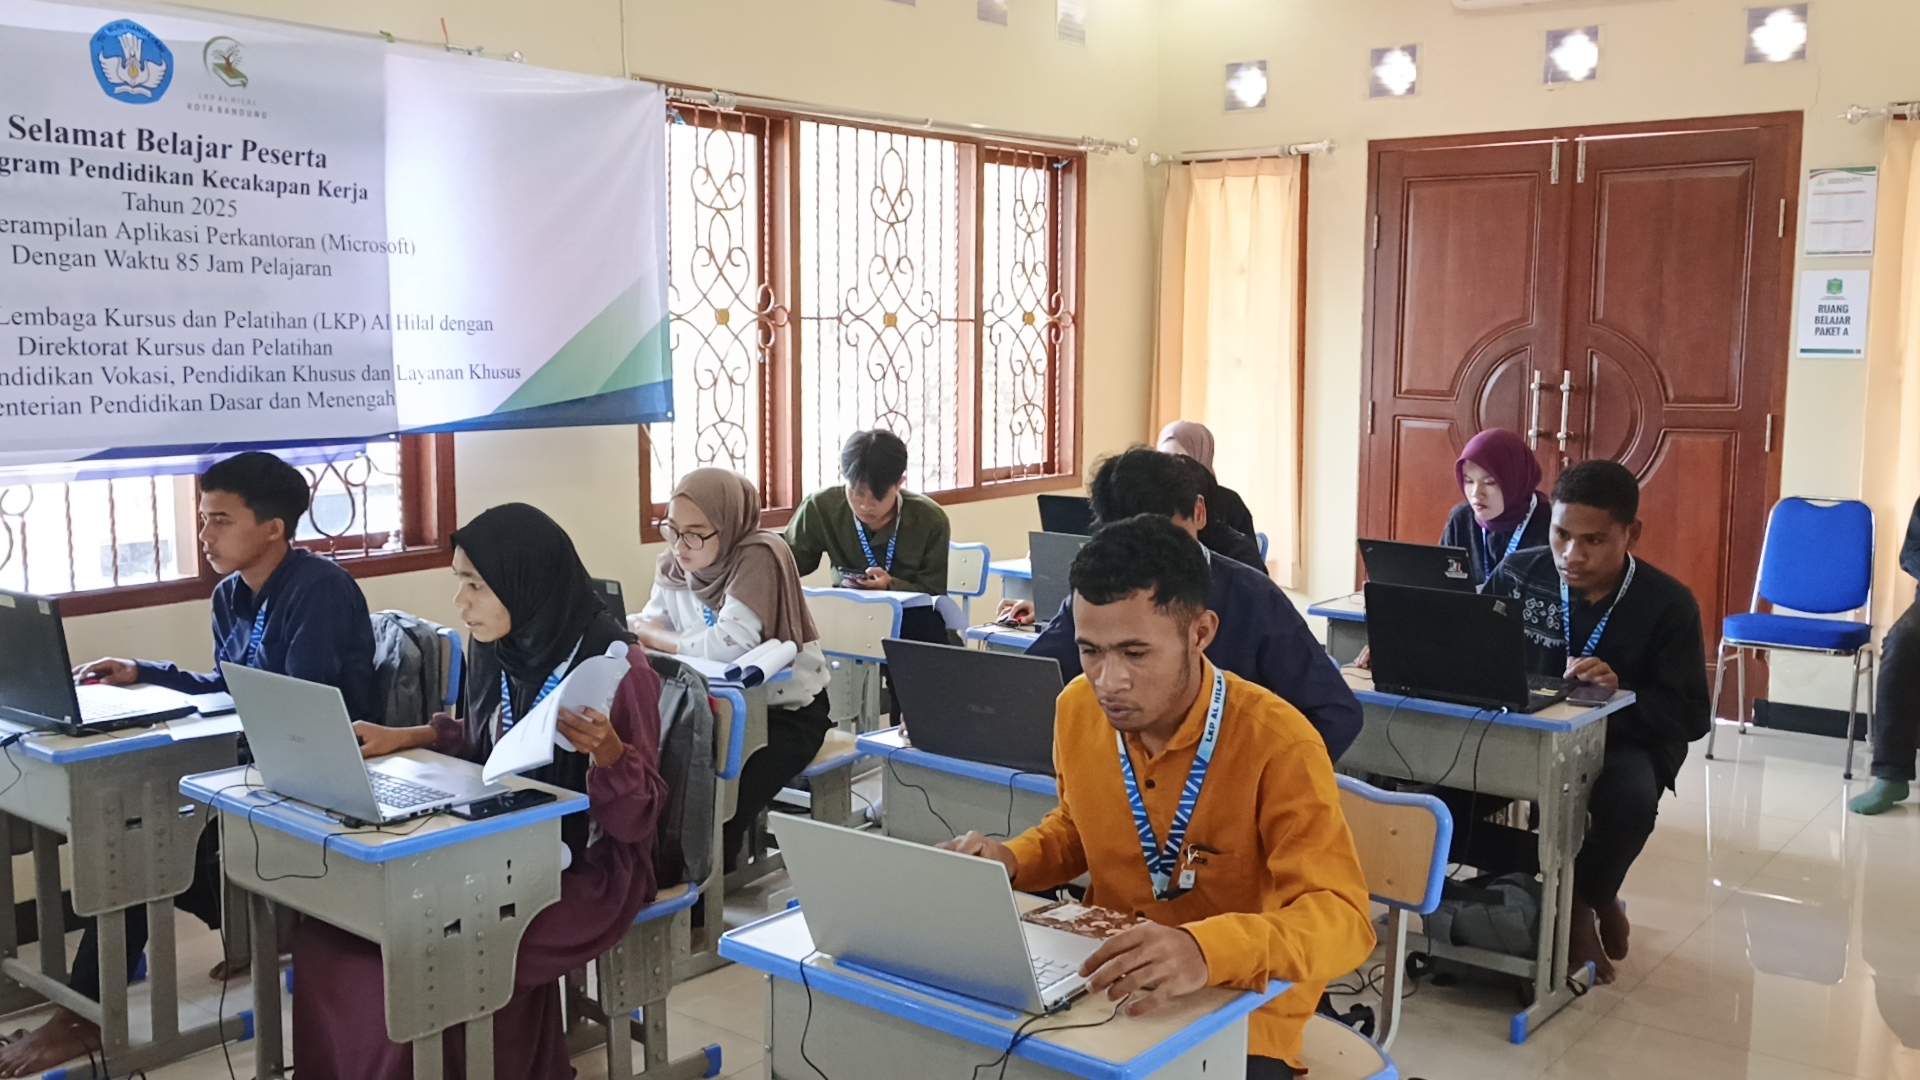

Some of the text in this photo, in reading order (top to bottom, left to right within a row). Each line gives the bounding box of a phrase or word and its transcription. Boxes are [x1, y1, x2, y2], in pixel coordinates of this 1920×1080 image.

[187, 103, 267, 119] KOTA BANDUNG
[9, 115, 326, 168] Selamat Belajar Peserta
[70, 157, 195, 186] Pendidikan
[203, 169, 310, 198] Kecakapan
[318, 180, 367, 204] Kerja
[122, 192, 237, 217] Tahun 2025
[116, 221, 199, 245] Aplikasi
[207, 226, 315, 249] Perkantoran
[321, 234, 415, 256] (Microsoft)
[12, 245, 332, 280] Dengan Waktu 85 Jam Pelajaran
[105, 308, 175, 327] Kursus
[183, 310, 216, 327] dan
[225, 311, 307, 329] Pelatihan
[313, 311, 367, 333] (LKP)
[371, 314, 389, 330] Al
[397, 314, 433, 330] Hilal
[440, 315, 493, 335] dengan
[1815, 316, 1851, 325] BELAJAR
[1818, 304, 1849, 314] RUANG
[1815, 327, 1849, 336] PAKET A
[19, 336, 333, 356] Direktorat Kursus dan Pelatihan
[101, 366, 175, 387] Vokasi,
[183, 365, 286, 383] Pendidikan
[293, 365, 355, 382] Khusus
[361, 364, 390, 381] dan
[396, 365, 464, 385] Layanan
[469, 364, 521, 379] Khusus
[91, 394, 203, 414] Pendidikan
[211, 394, 263, 410] Dasar
[269, 392, 300, 409] dan
[307, 389, 395, 411] Menengah
[1205, 675, 1223, 743] LKP AL HILAL
